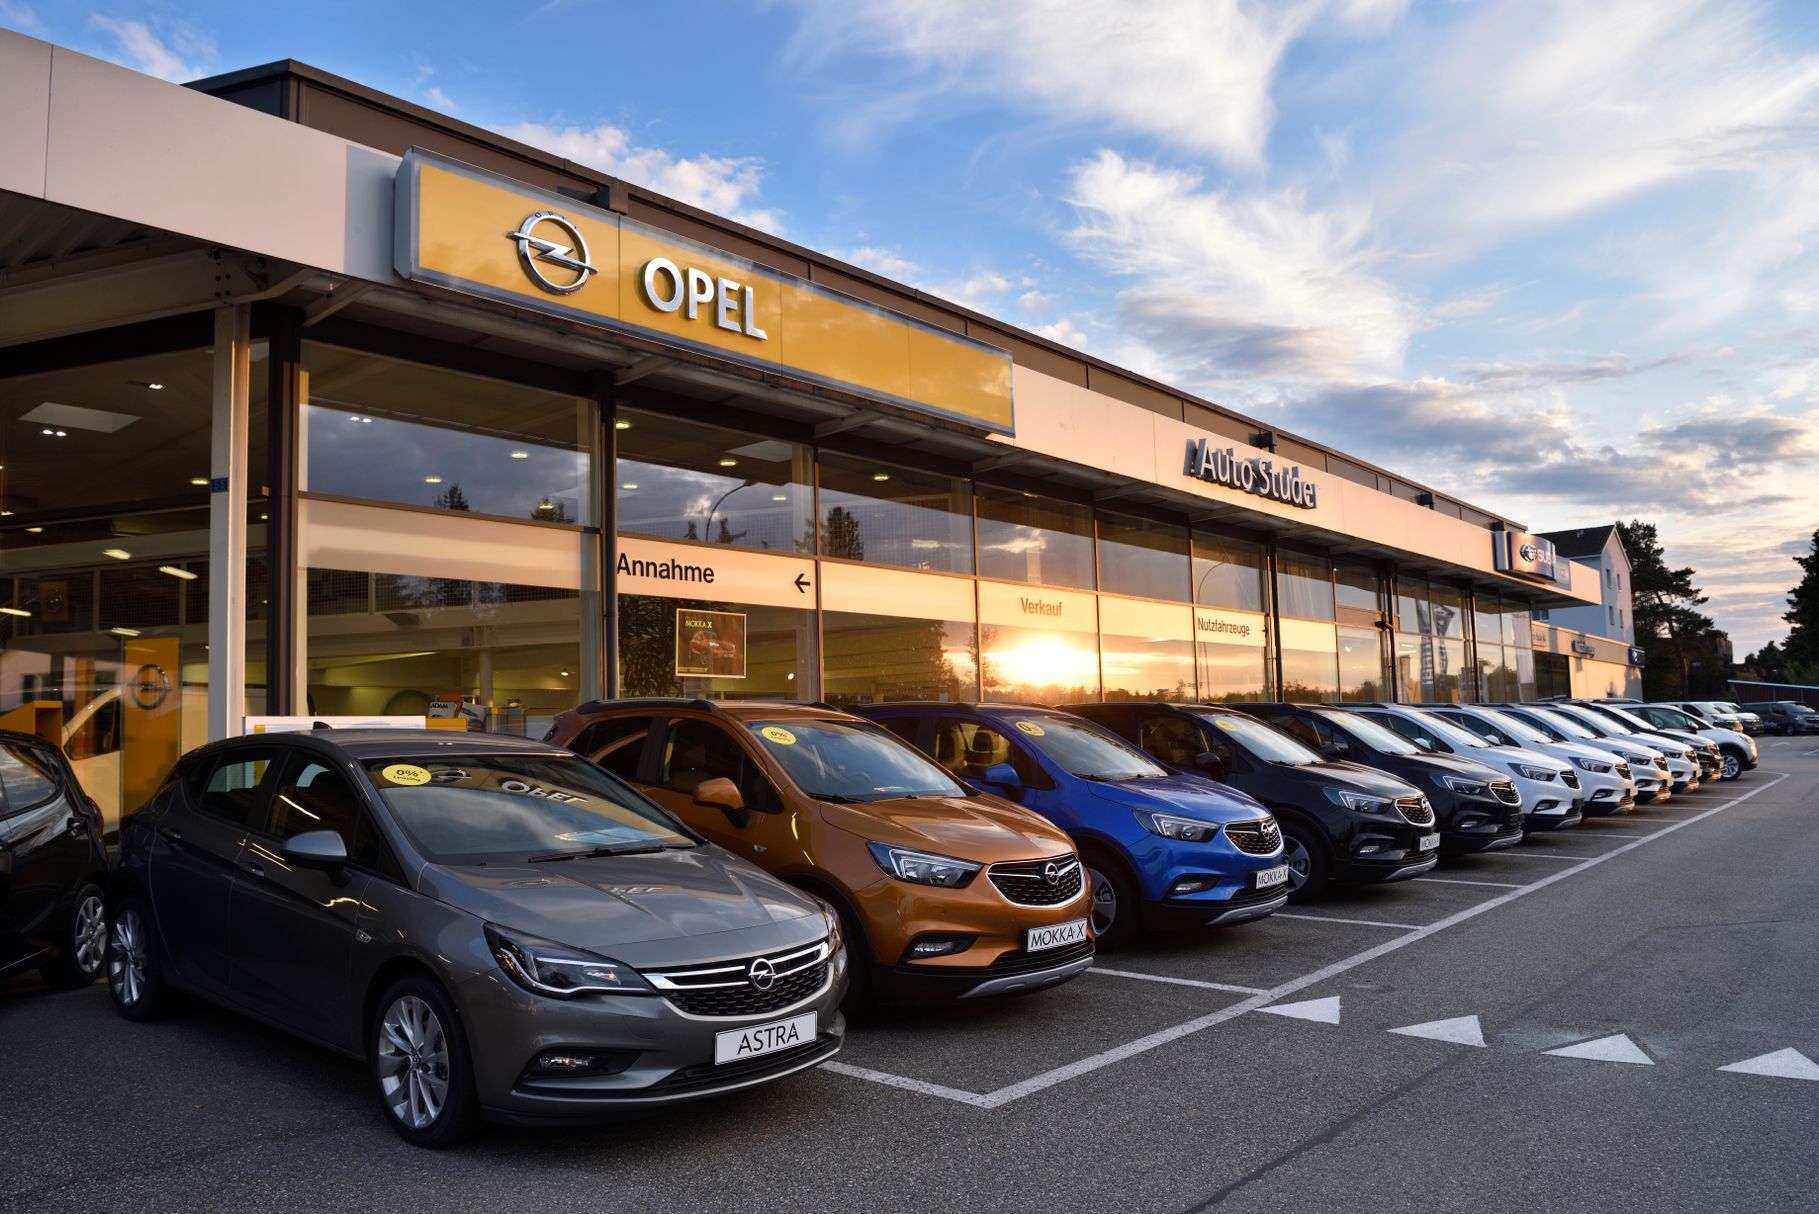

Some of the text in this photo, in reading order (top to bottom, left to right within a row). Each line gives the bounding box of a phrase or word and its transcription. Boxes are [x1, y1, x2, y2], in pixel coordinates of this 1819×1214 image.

[643, 256, 768, 341] OPEL
[1200, 439, 1253, 491] Auto
[616, 552, 715, 584] Annahme
[1020, 596, 1063, 617] Verkauf
[685, 619, 713, 629] MOKKA X
[1197, 616, 1251, 637] Nutzfahrzeuge
[737, 1022, 799, 1055] ASTRA
